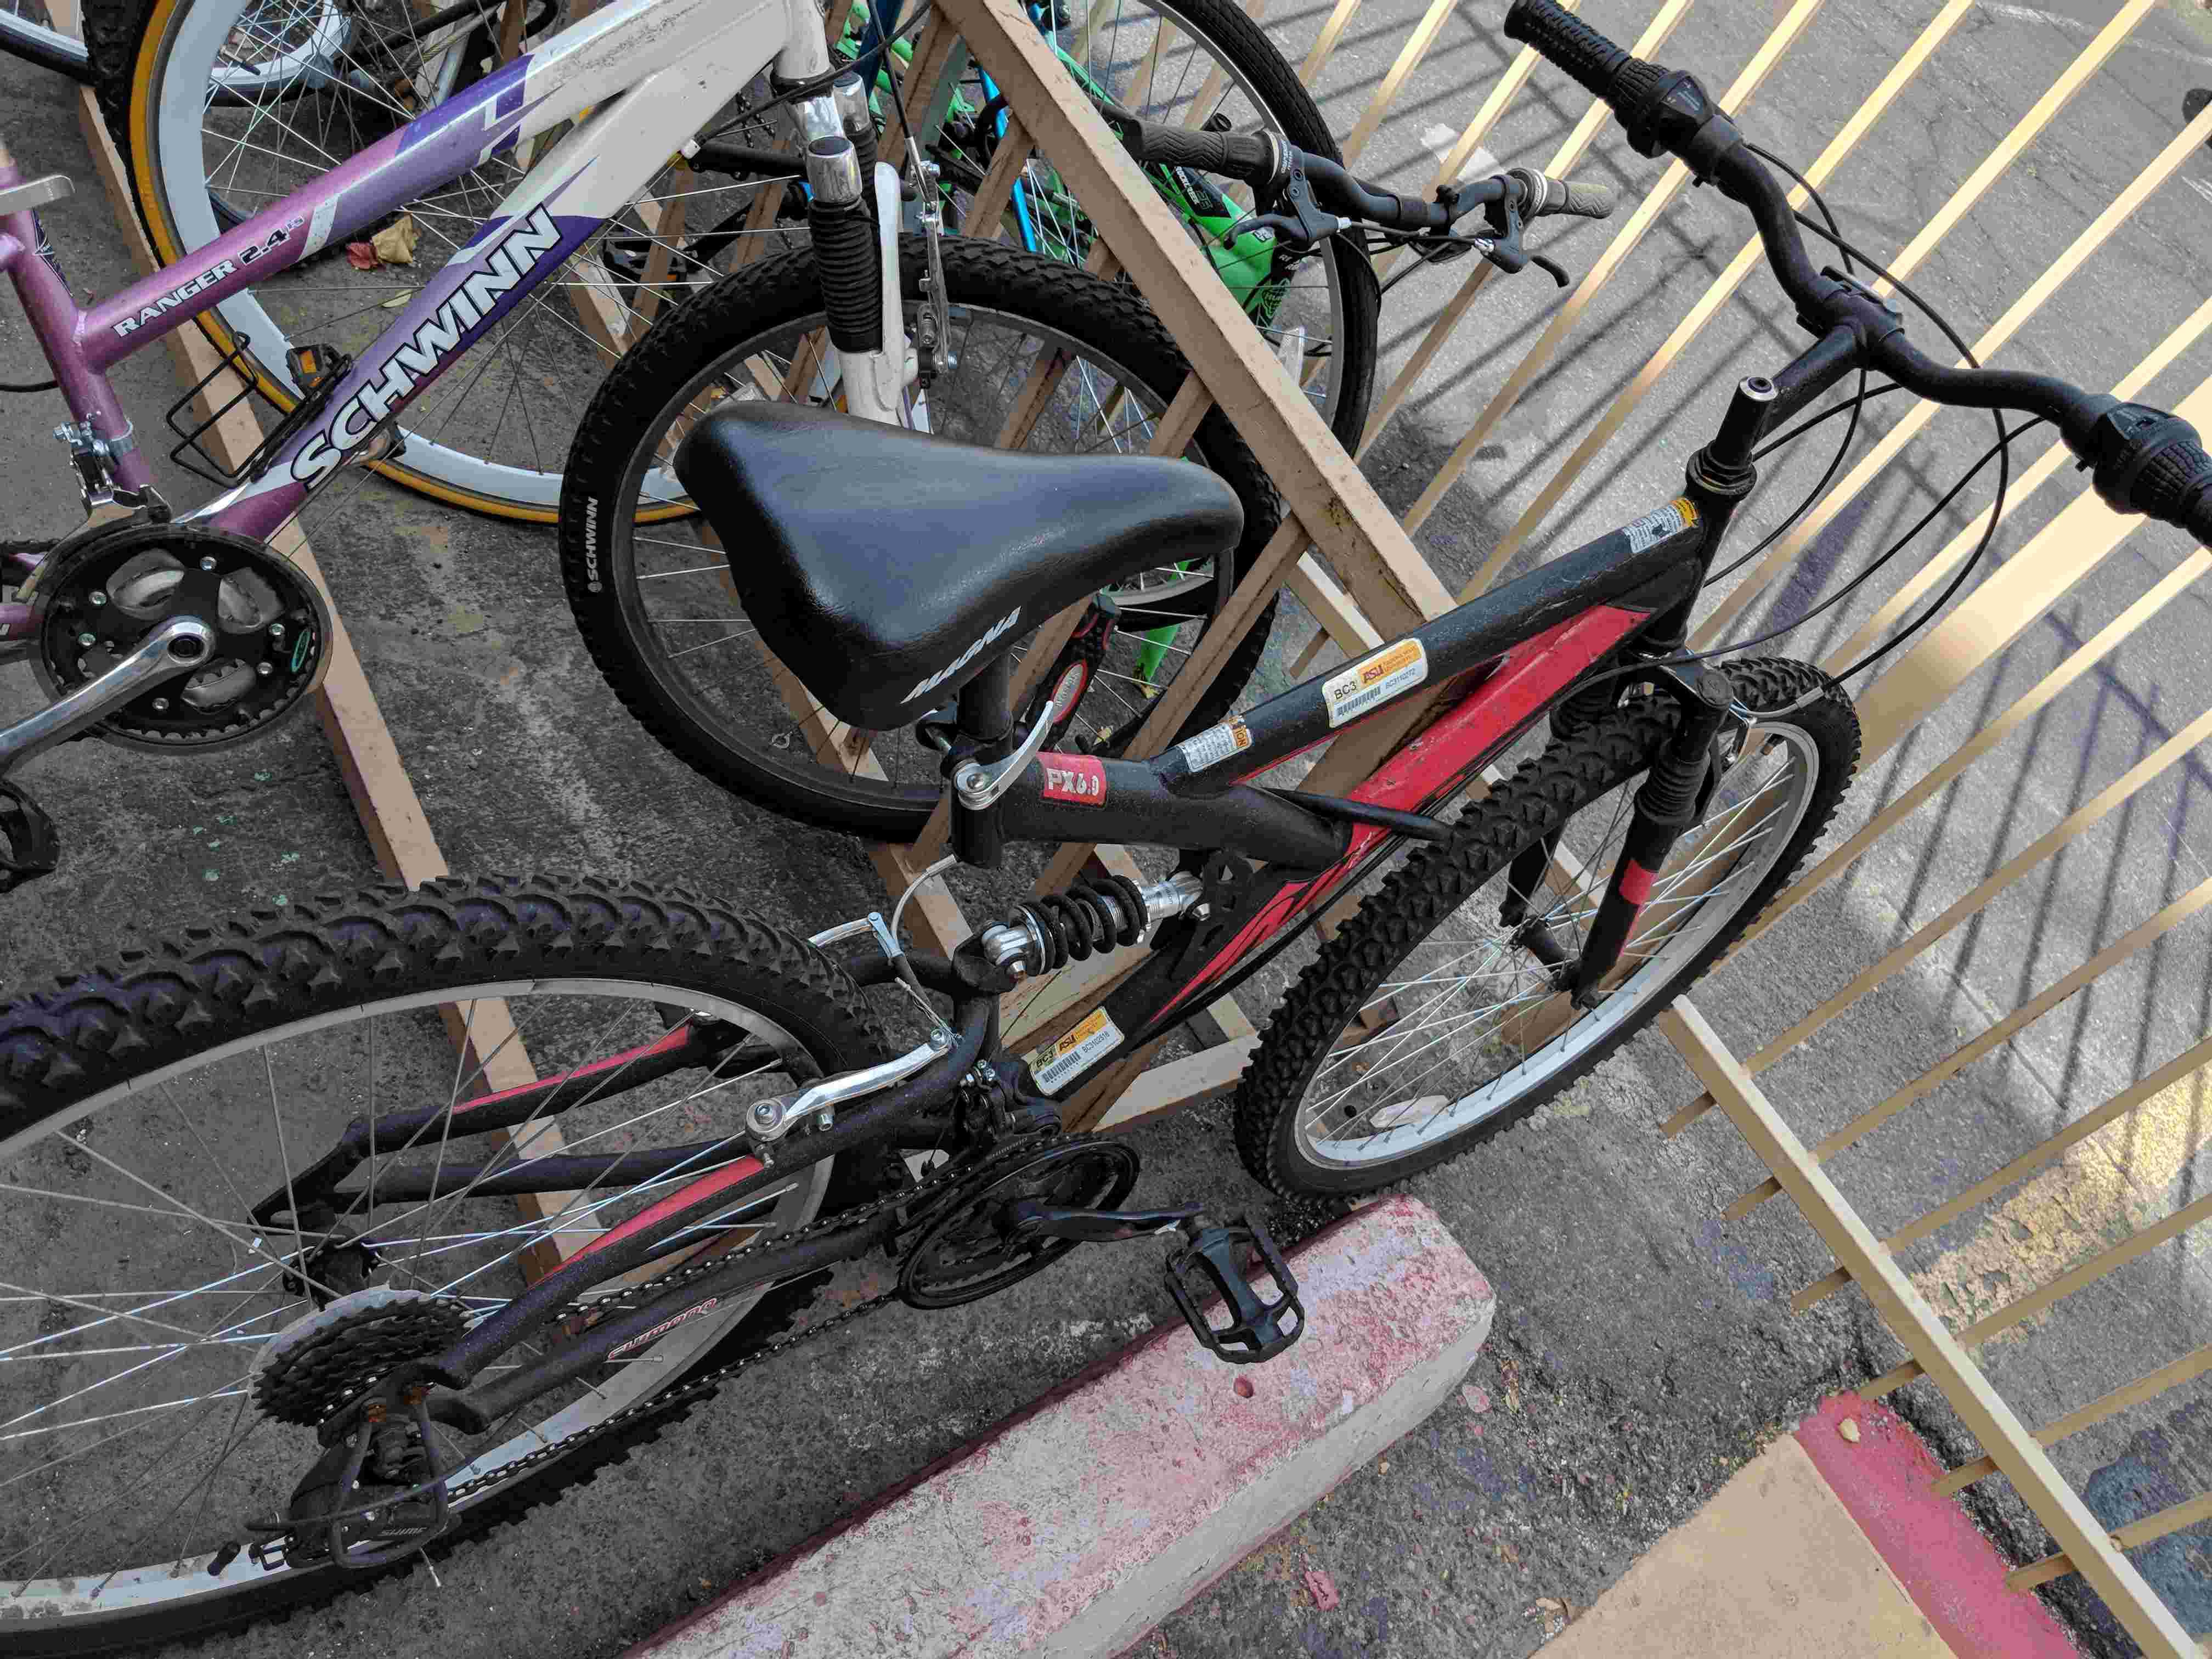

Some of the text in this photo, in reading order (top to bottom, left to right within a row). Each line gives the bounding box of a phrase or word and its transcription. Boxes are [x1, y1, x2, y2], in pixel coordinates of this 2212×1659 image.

[111, 260, 238, 337] RANGER
[239, 228, 290, 265] 2.4
[291, 202, 563, 491] SCHWINN
[586, 496, 599, 582] SCHWINN
[1334, 681, 1357, 699] BC3
